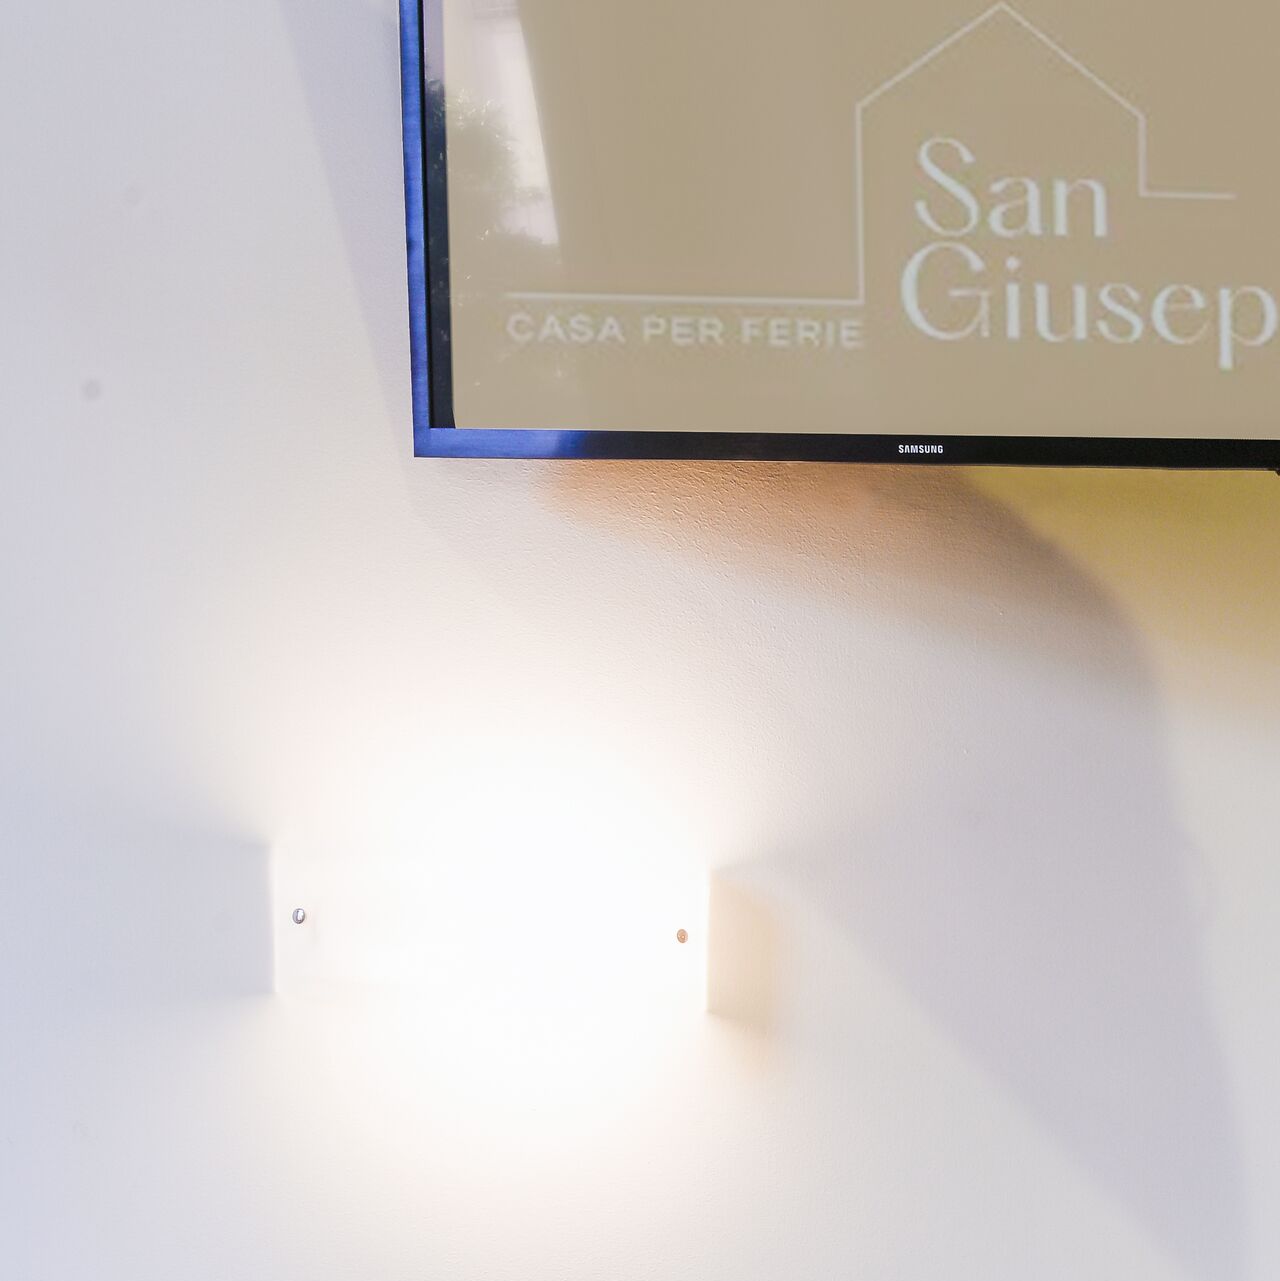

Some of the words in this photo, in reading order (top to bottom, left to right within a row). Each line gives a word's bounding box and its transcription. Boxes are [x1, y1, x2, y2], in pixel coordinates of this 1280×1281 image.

[914, 136, 1108, 239] San
[505, 311, 626, 343] CASA
[642, 315, 724, 346] PER
[741, 317, 864, 348] FERIE
[898, 444, 944, 454] SAMSUNG
